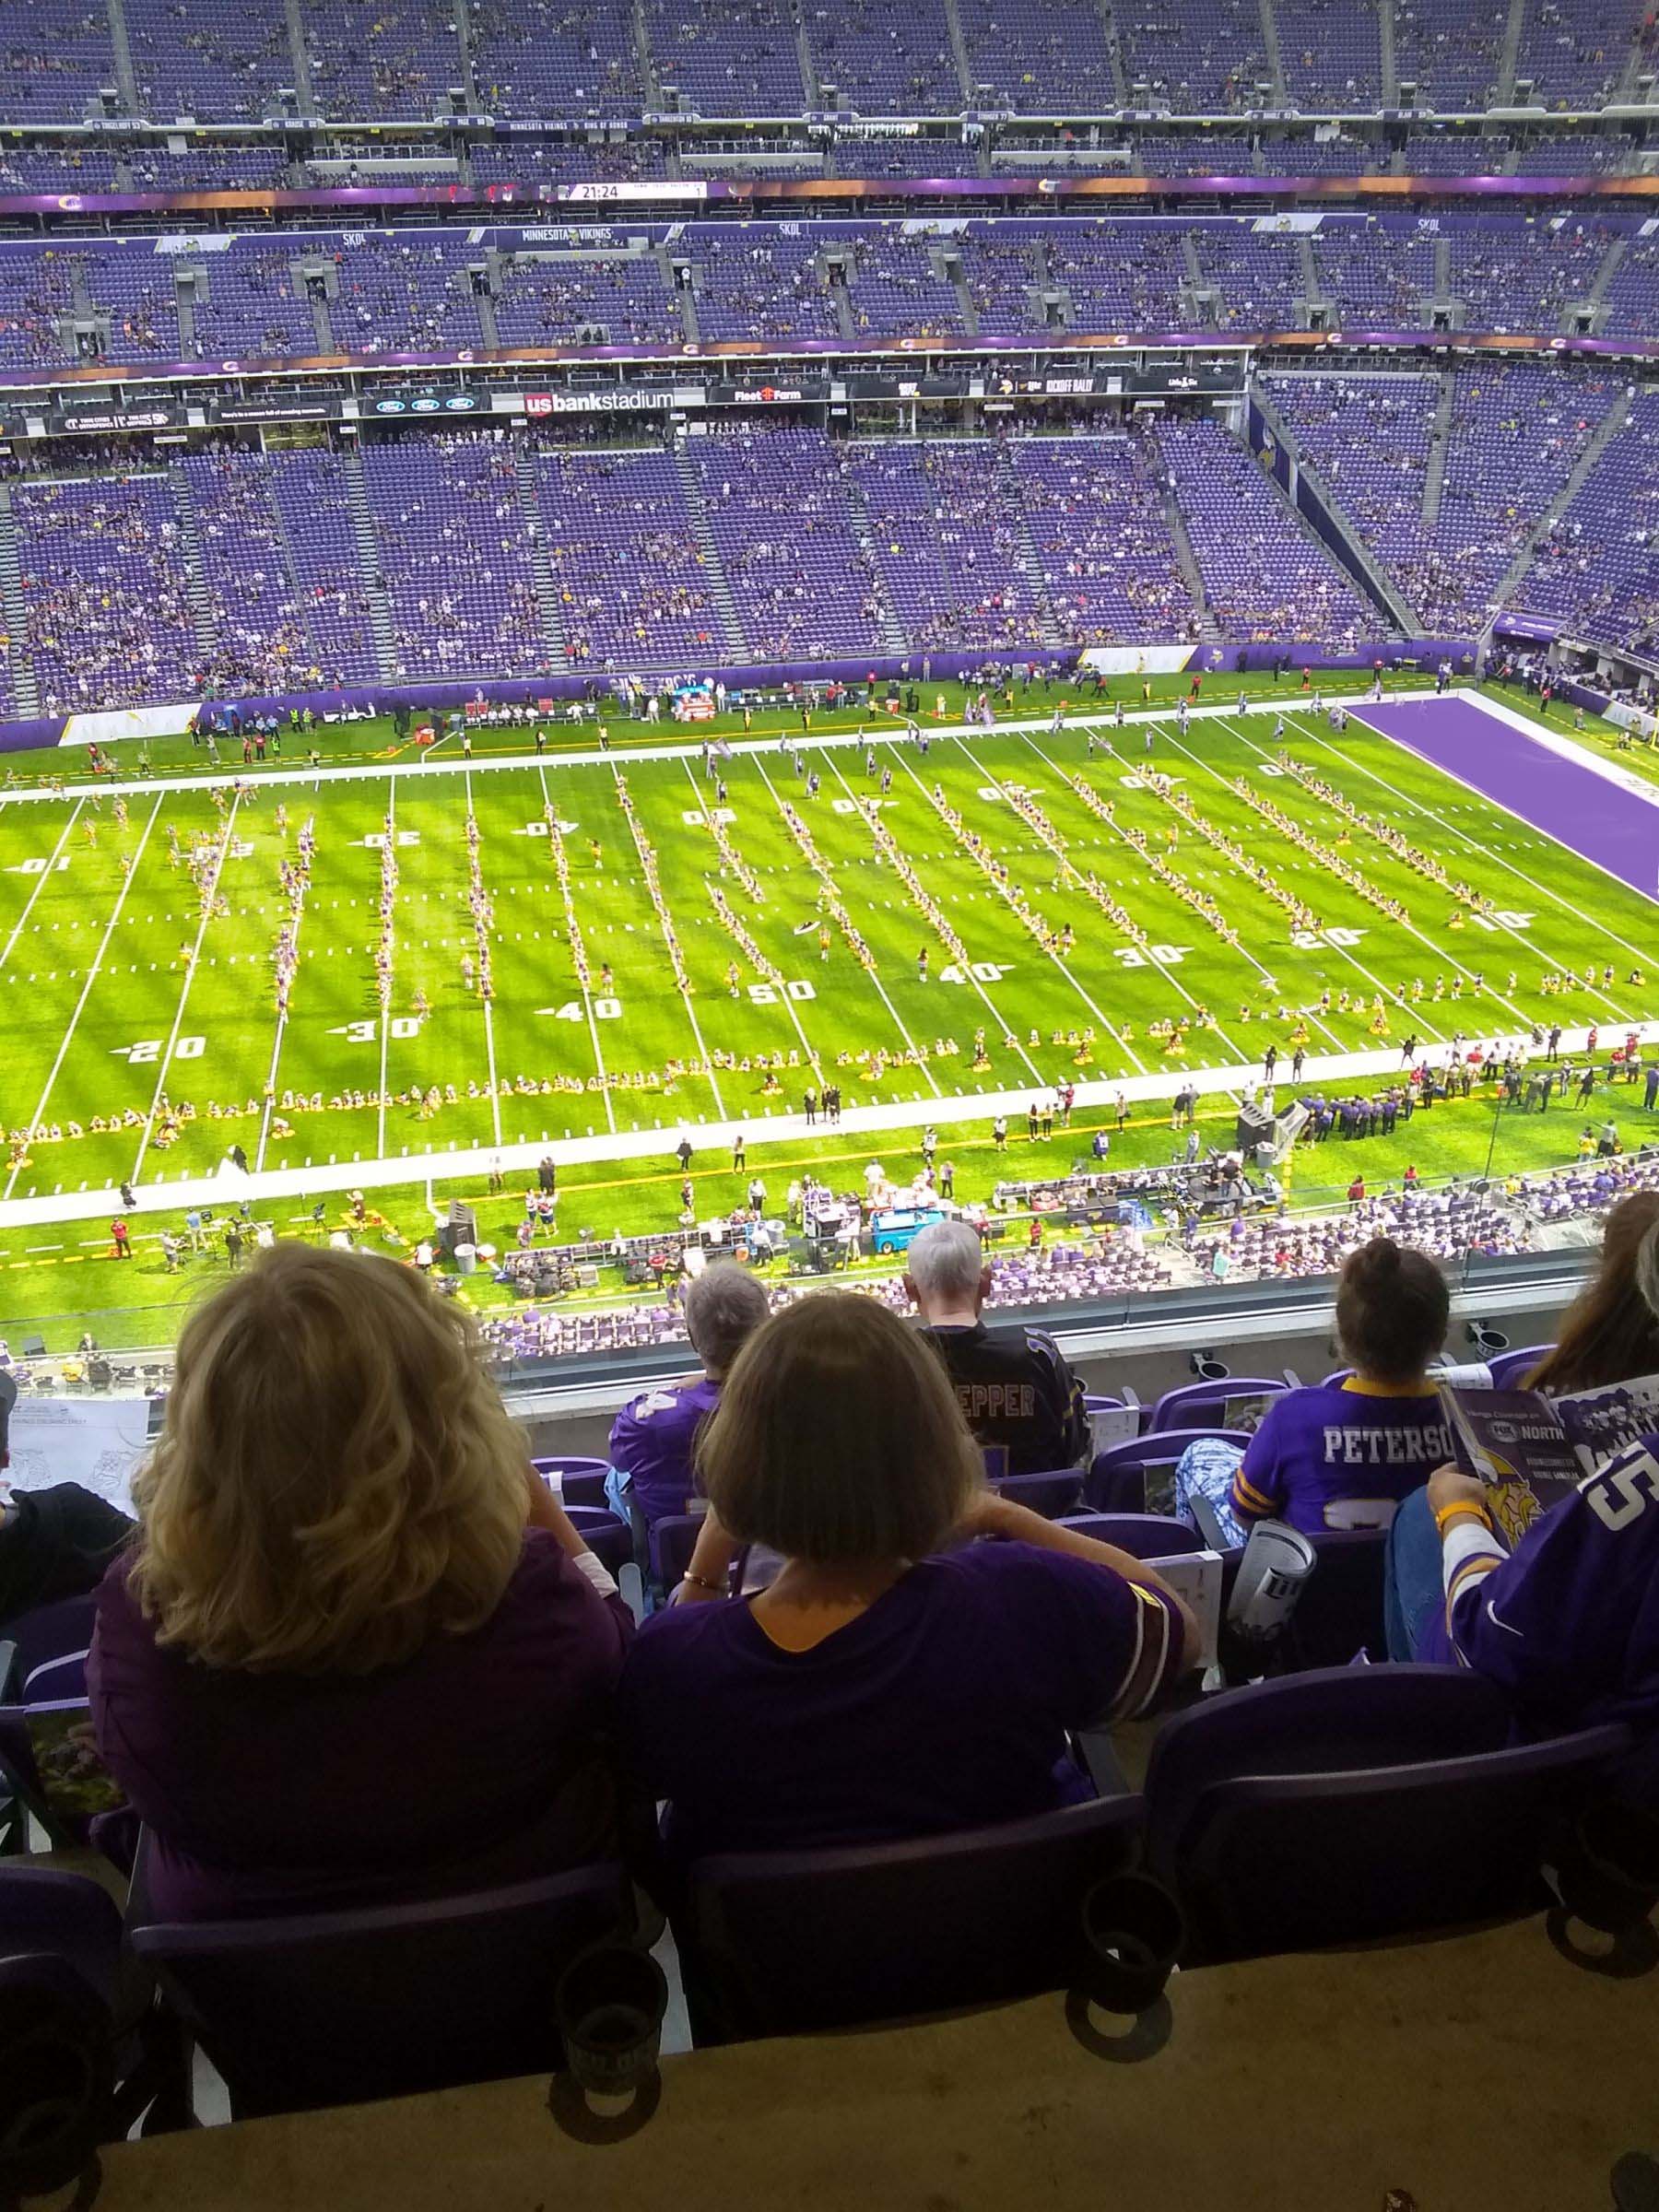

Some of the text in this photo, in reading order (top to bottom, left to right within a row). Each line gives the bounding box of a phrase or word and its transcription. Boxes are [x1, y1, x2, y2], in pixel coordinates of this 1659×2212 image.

[545, 122, 568, 130] VIKINGS
[582, 186, 618, 198] 21:24
[523, 227, 612, 241] MINNESOTA VIKINGS
[779, 223, 802, 235] SKOL
[1418, 218, 1441, 230] SKOL
[343, 232, 366, 246] SKOL
[735, 390, 802, 401] Fleet Farm
[1046, 379, 1072, 393] KICKOFF
[1073, 379, 1094, 392] RALLY
[1470, 910, 1532, 932] 10
[1290, 926, 1361, 950] 20
[1113, 944, 1185, 968] 30
[939, 961, 1003, 985] 40
[747, 980, 818, 1005] 50
[555, 998, 623, 1022] 40
[347, 1017, 420, 1042] 30
[128, 1035, 206, 1064] 20
[956, 1384, 1034, 1418] EPPER
[1523, 1426, 1564, 1440] NORTH
[1324, 1425, 1456, 1464] PETERSO
